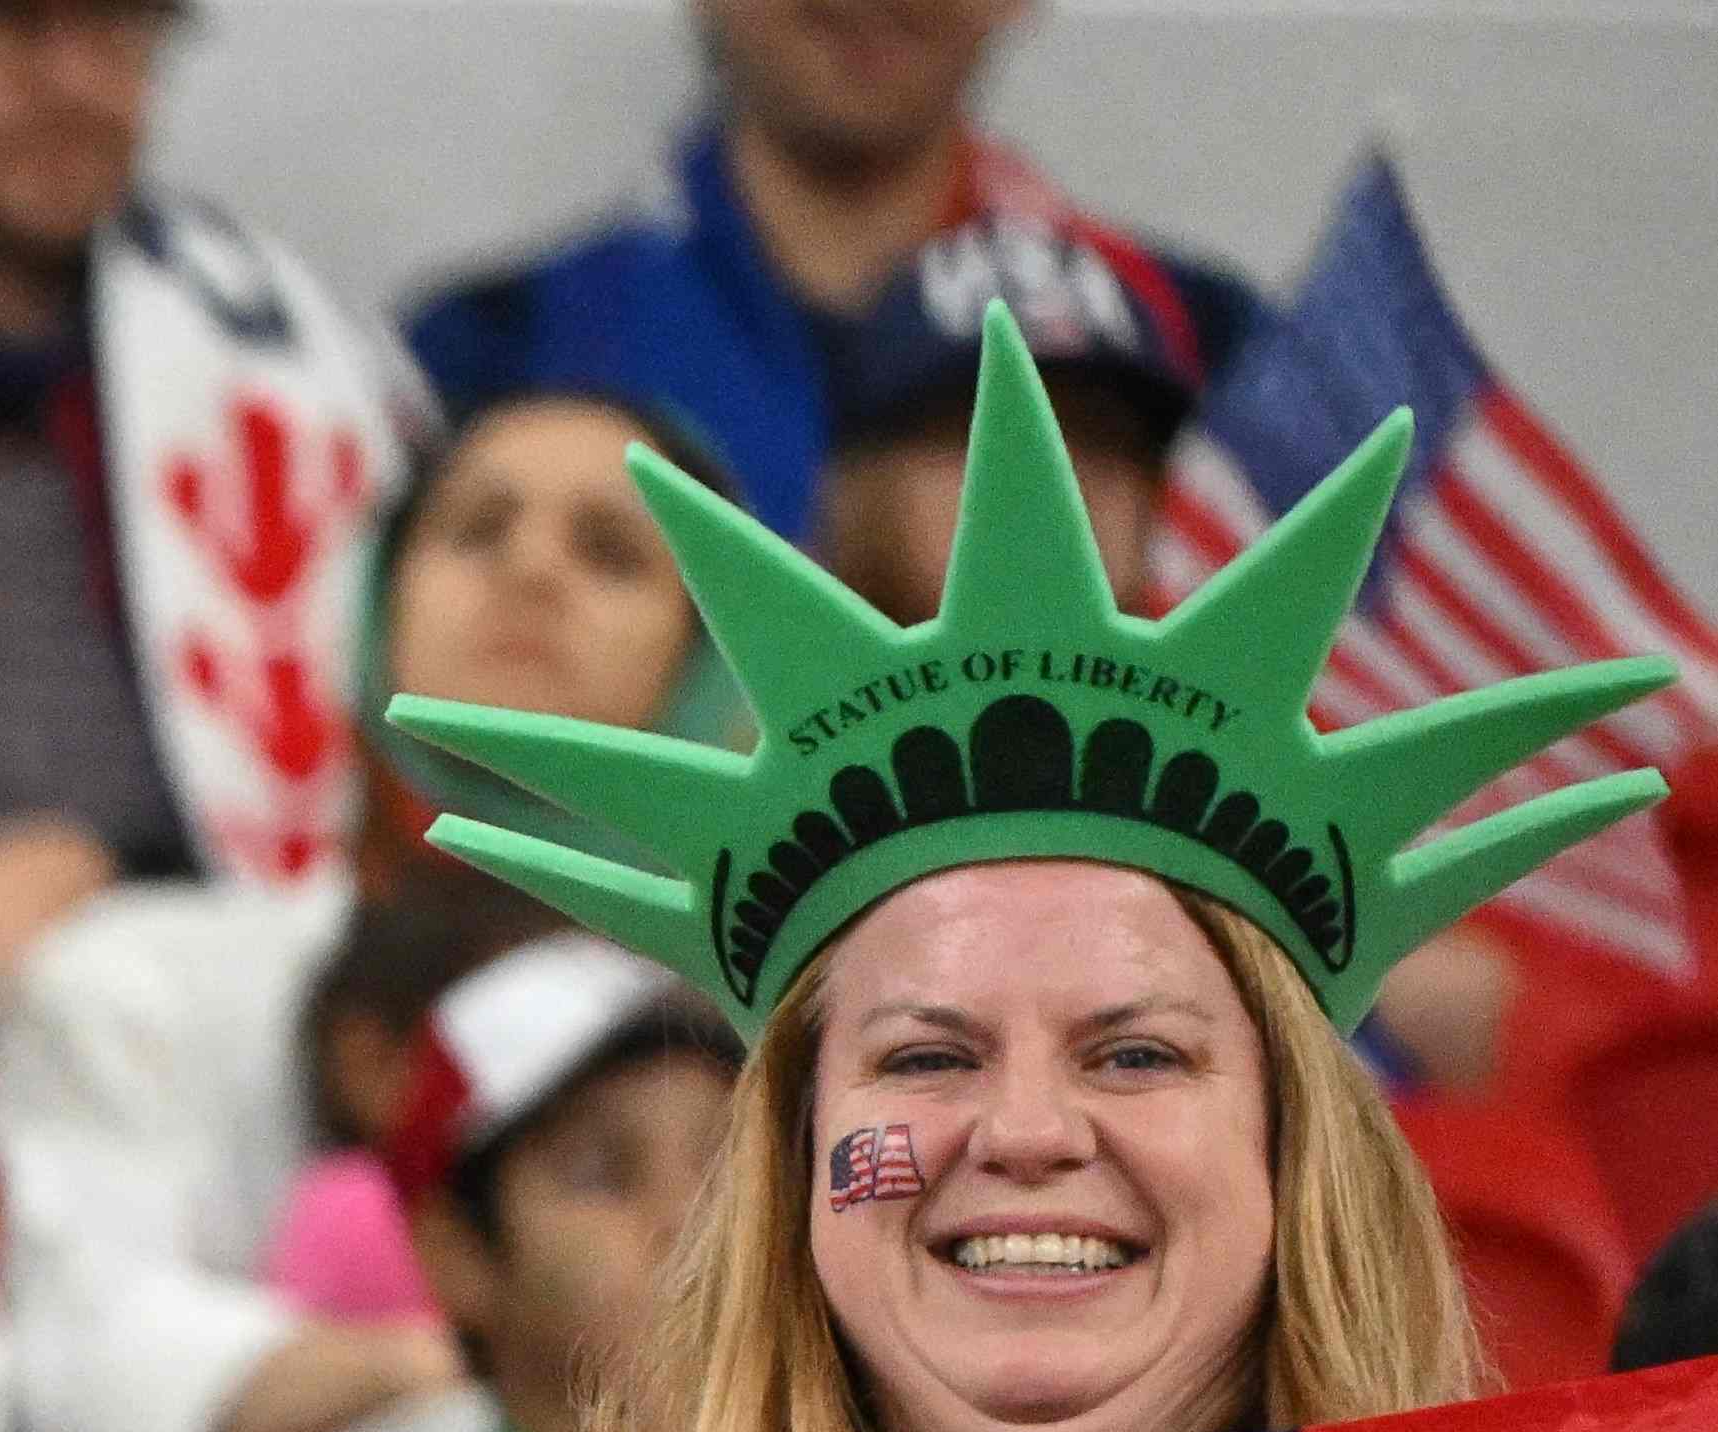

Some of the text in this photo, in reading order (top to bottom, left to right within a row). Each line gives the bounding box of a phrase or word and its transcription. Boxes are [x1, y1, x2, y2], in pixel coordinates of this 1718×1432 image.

[788, 648, 1241, 757] STATUE OF LIBERTY
